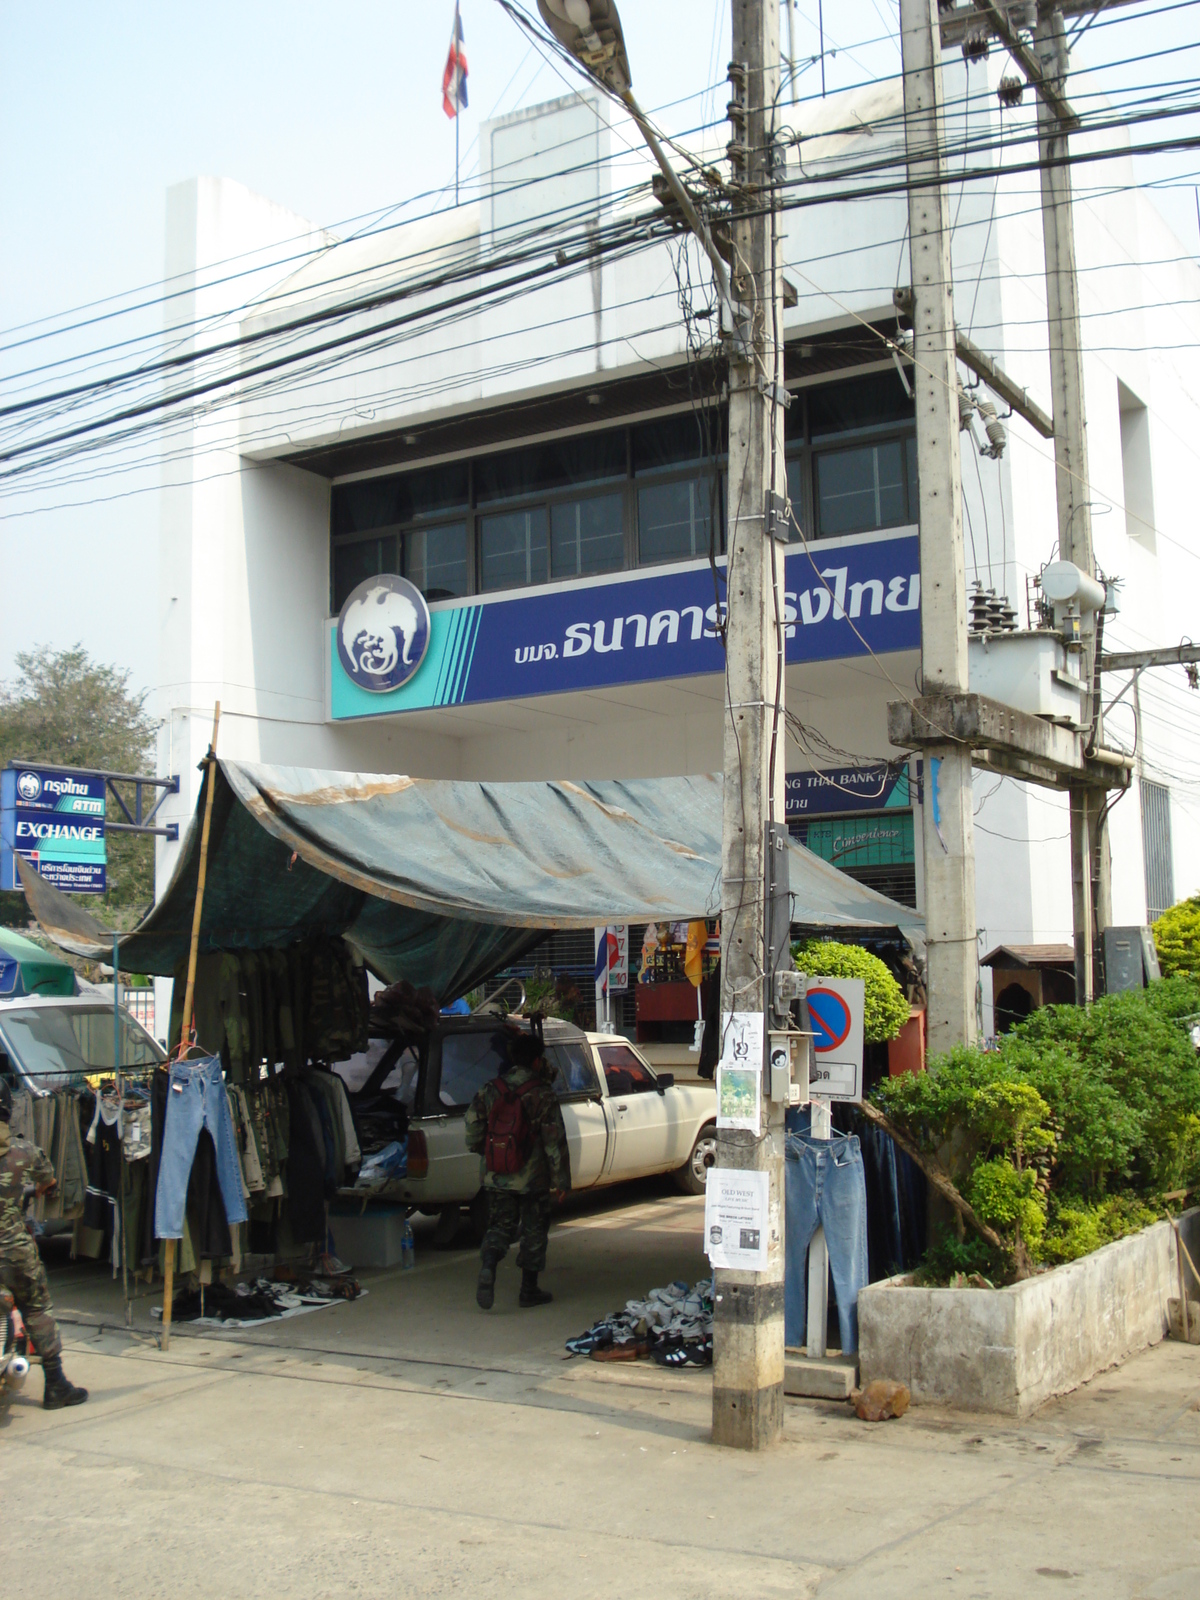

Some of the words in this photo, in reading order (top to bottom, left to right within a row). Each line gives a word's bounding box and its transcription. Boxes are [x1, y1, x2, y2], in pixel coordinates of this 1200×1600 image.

[514, 643, 559, 664] บมจ.
[562, 566, 920, 658] ธนาคารรุงไทย
[44, 778, 89, 796] กรุงไทย
[806, 775, 835, 788] THAI
[840, 773, 875, 785] BANK
[73, 800, 102, 812] ATM
[16, 821, 102, 841] EXCHANGE
[813, 829, 832, 839] KTB
[833, 827, 900, 852] Convenience
[615, 973, 627, 986] 10
